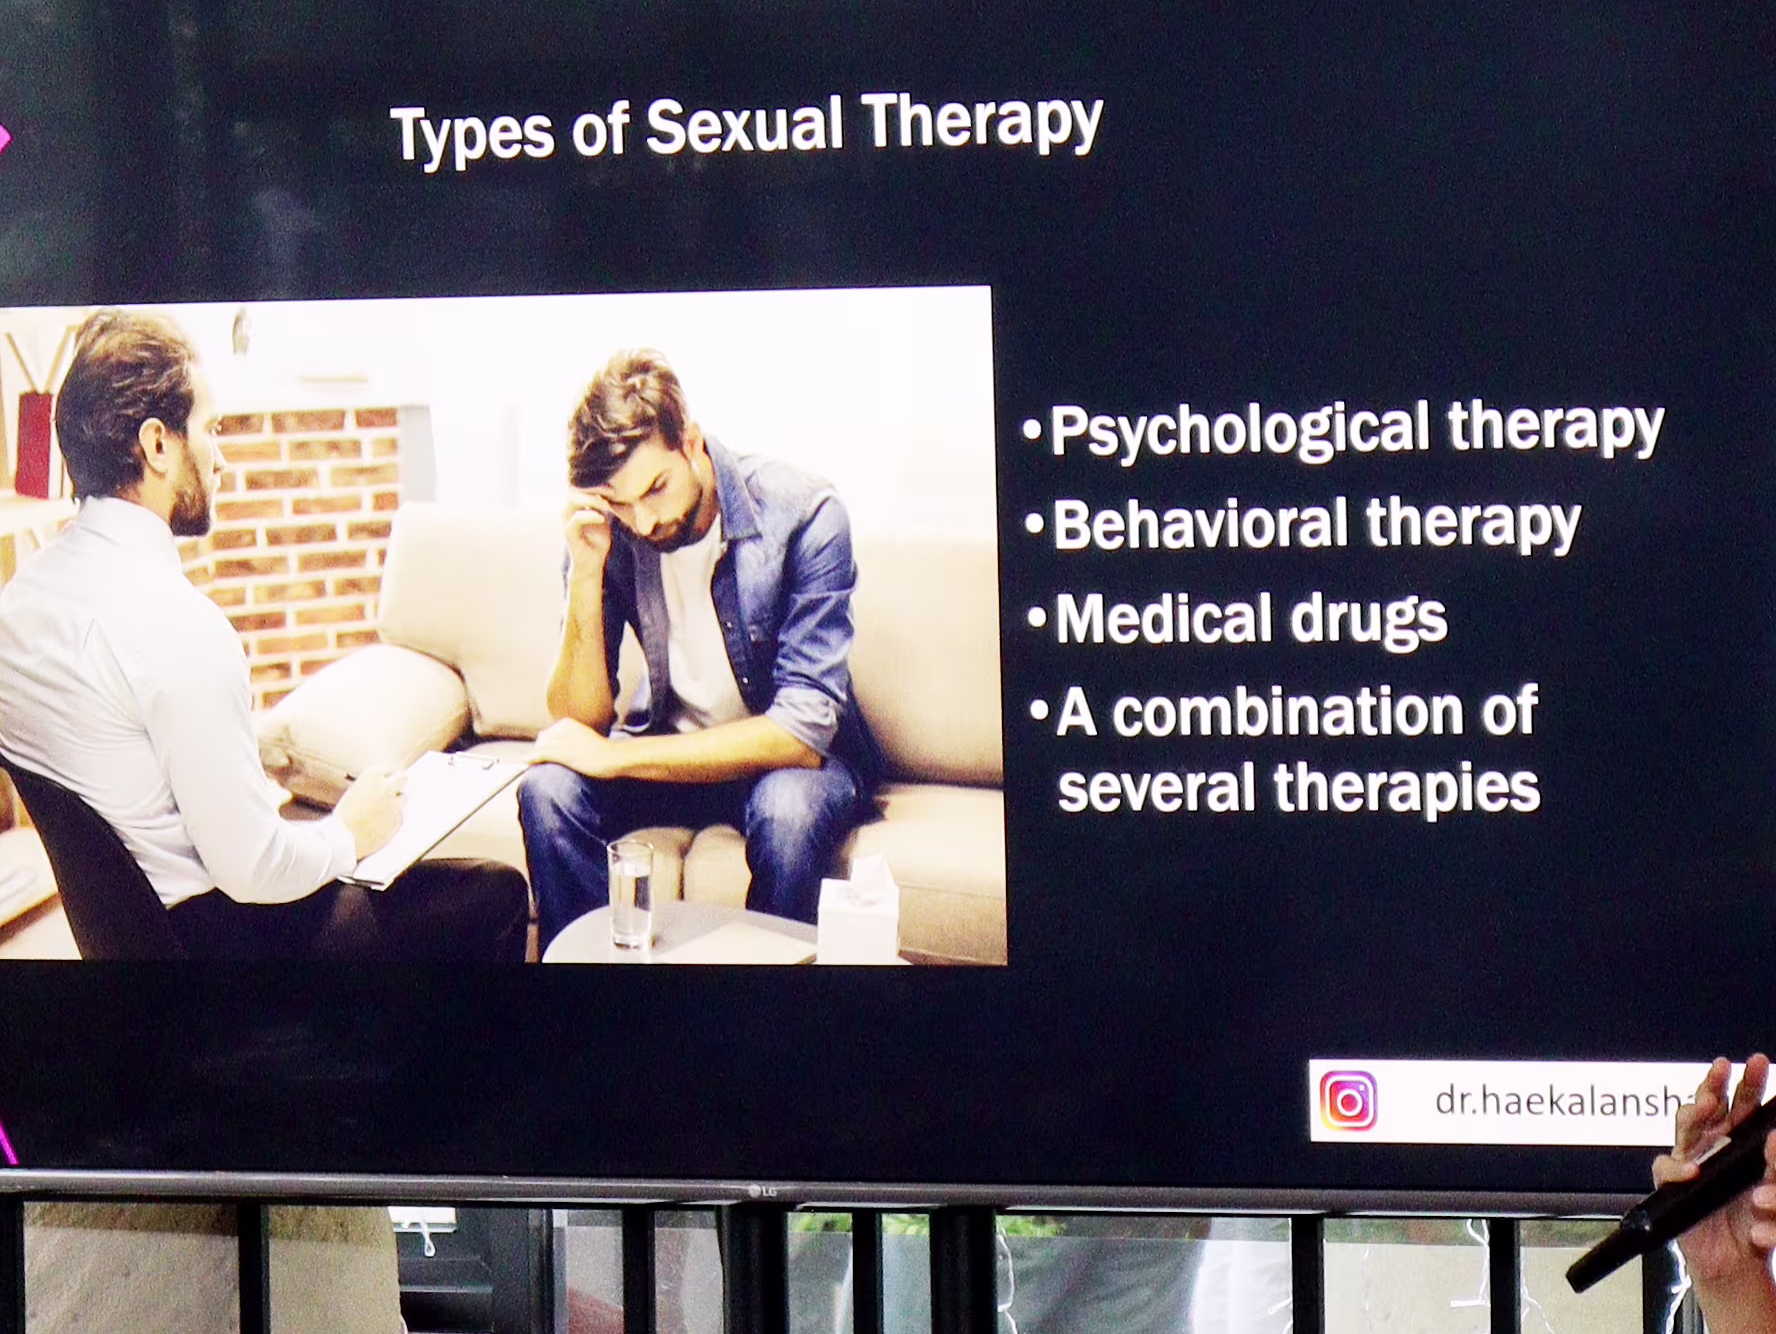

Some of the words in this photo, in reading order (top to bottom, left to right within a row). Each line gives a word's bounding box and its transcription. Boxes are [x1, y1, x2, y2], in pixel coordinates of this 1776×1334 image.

[390, 108, 554, 173] Types
[573, 100, 630, 156] of
[647, 95, 842, 154] Sexual
[861, 93, 1103, 155] Therapy
[1053, 400, 1428, 467] Psychological
[1448, 399, 1665, 459] therapy
[1055, 496, 1347, 549] Behavioral
[1366, 496, 1581, 556] therapy
[1057, 592, 1271, 643] Medical
[1290, 592, 1447, 653] drugs
[1057, 687, 1097, 735] A
[1113, 685, 1462, 736] combination
[1482, 683, 1538, 735] of
[1059, 762, 1254, 812] several
[1274, 761, 1540, 822] therapies
[761, 1186, 778, 1198] LG
